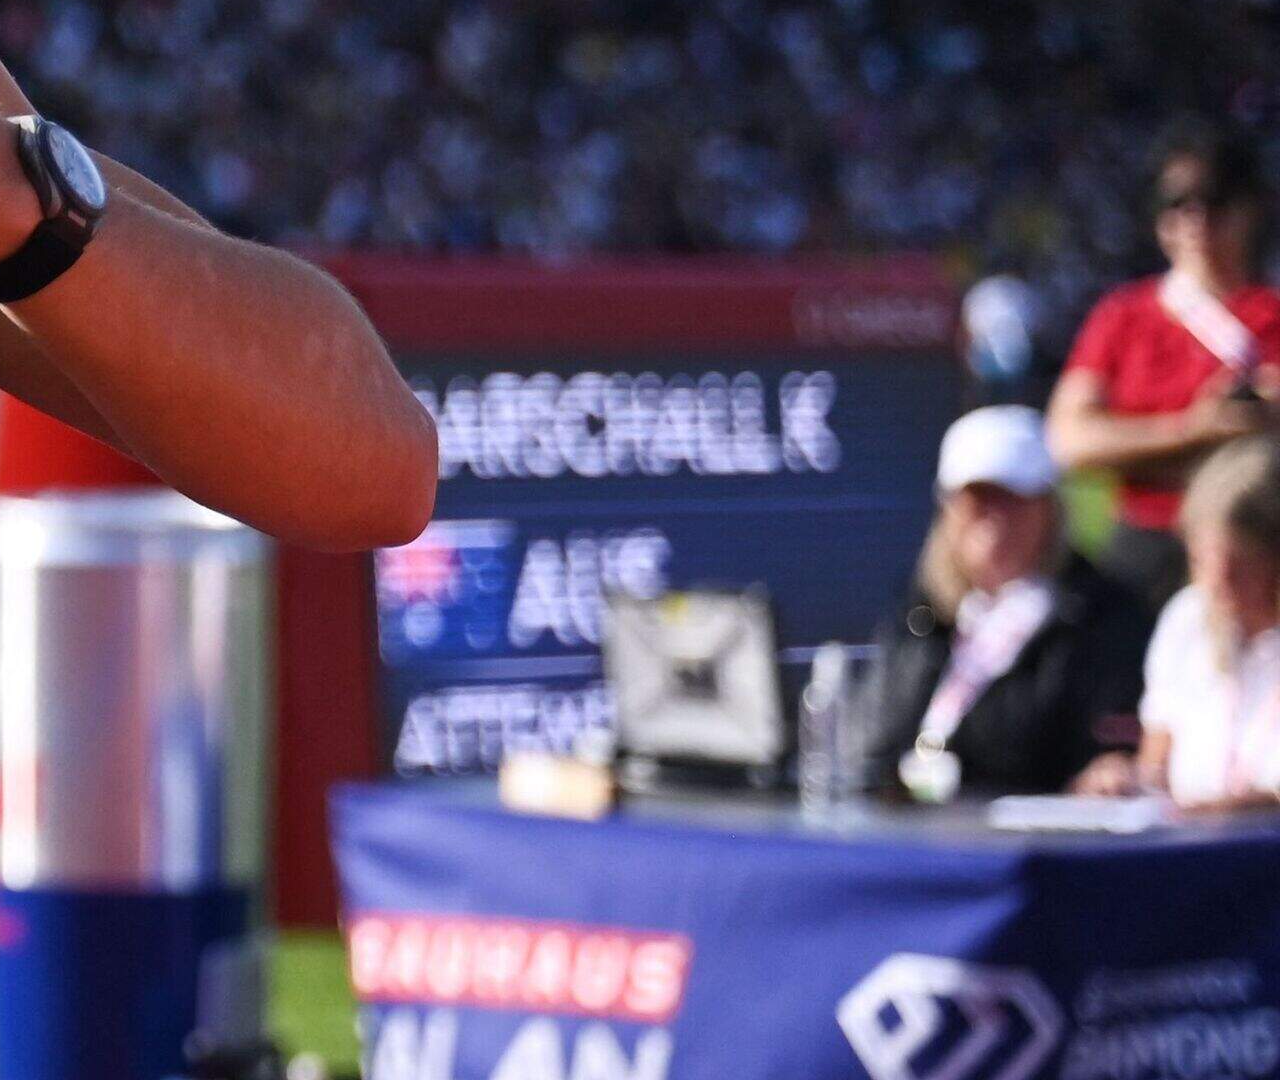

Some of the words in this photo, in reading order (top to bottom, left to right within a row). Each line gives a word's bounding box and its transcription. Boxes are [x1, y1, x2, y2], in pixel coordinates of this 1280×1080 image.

[410, 372, 783, 478] ARSCHALL
[778, 370, 841, 474] K
[349, 917, 685, 1015] BAUHAUS
